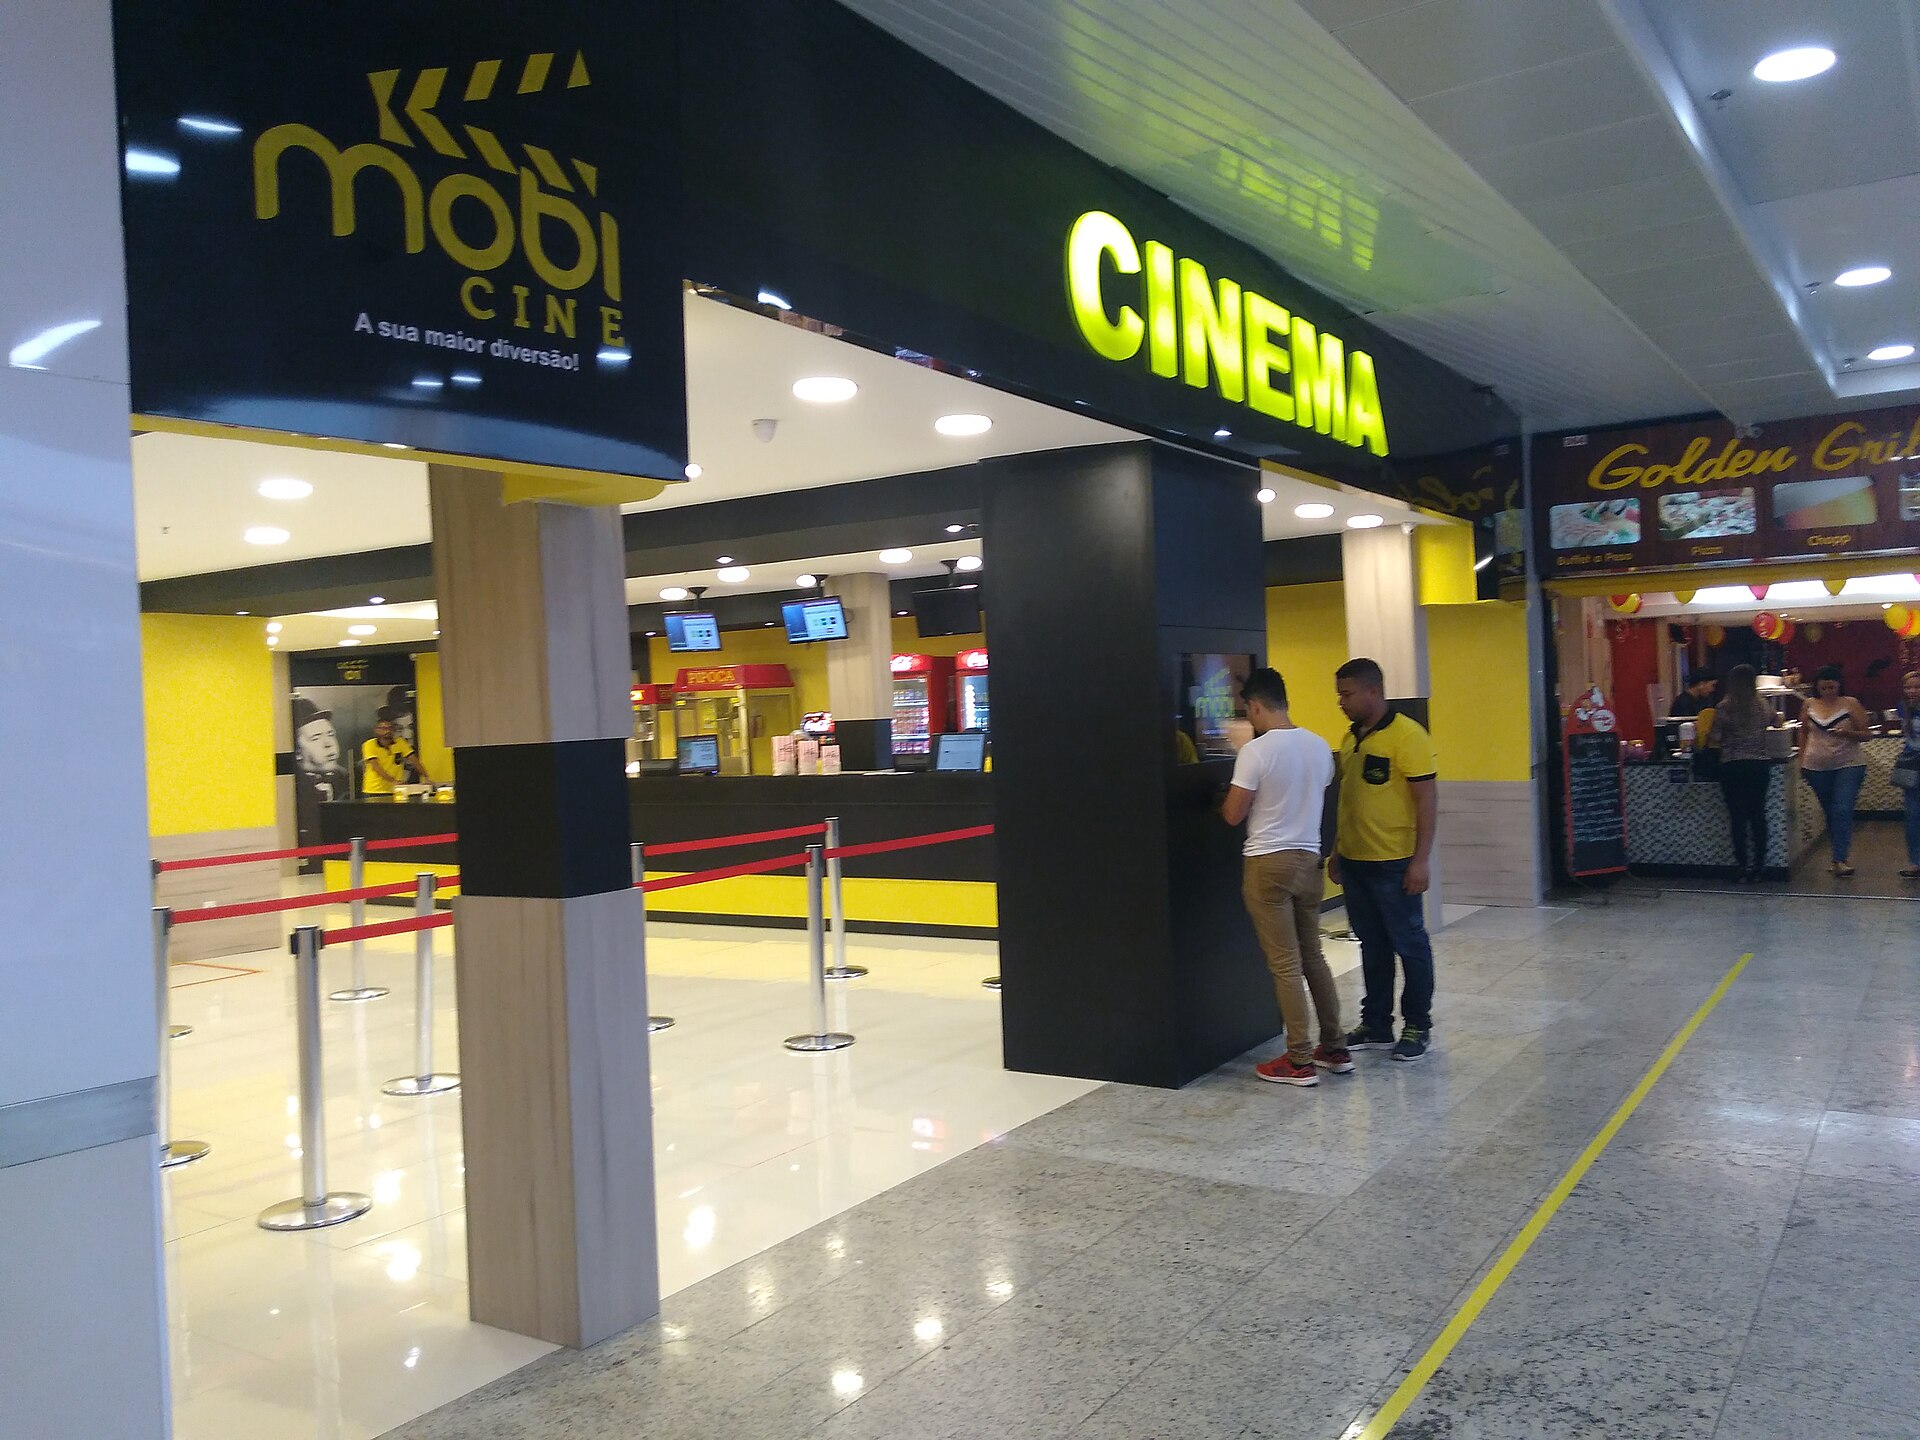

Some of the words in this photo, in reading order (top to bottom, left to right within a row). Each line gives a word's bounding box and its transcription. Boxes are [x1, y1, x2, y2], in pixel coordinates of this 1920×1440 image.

[253, 122, 621, 302] mobi
[354, 312, 374, 334] A
[378, 319, 419, 342] sua
[424, 330, 486, 354] maior
[490, 338, 580, 371] diversão!
[459, 276, 625, 348] CINE
[1065, 210, 1389, 458] CINEMA
[1587, 436, 1798, 491] Golden
